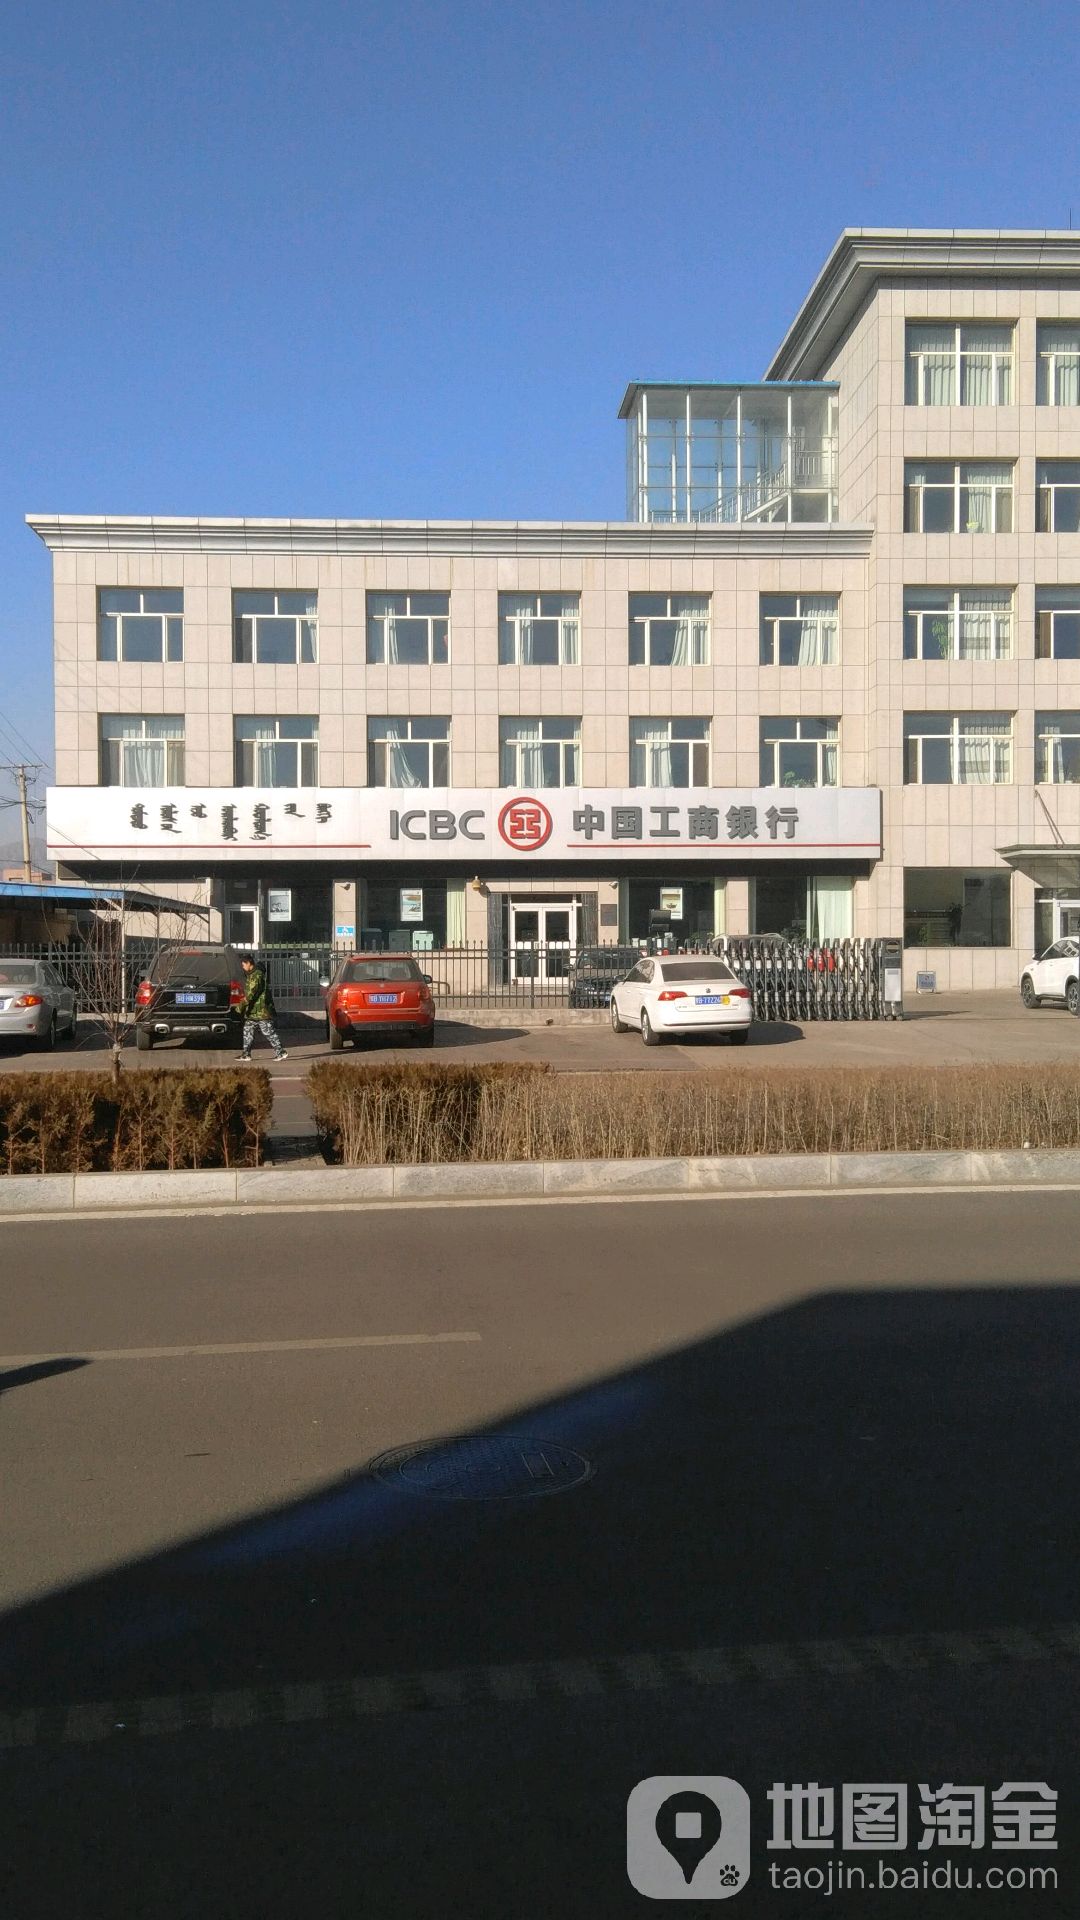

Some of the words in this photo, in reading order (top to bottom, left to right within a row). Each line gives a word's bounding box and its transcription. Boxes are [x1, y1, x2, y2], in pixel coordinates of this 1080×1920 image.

[390, 809, 485, 840] ICBC
[572, 804, 799, 840] 中国工商银行
